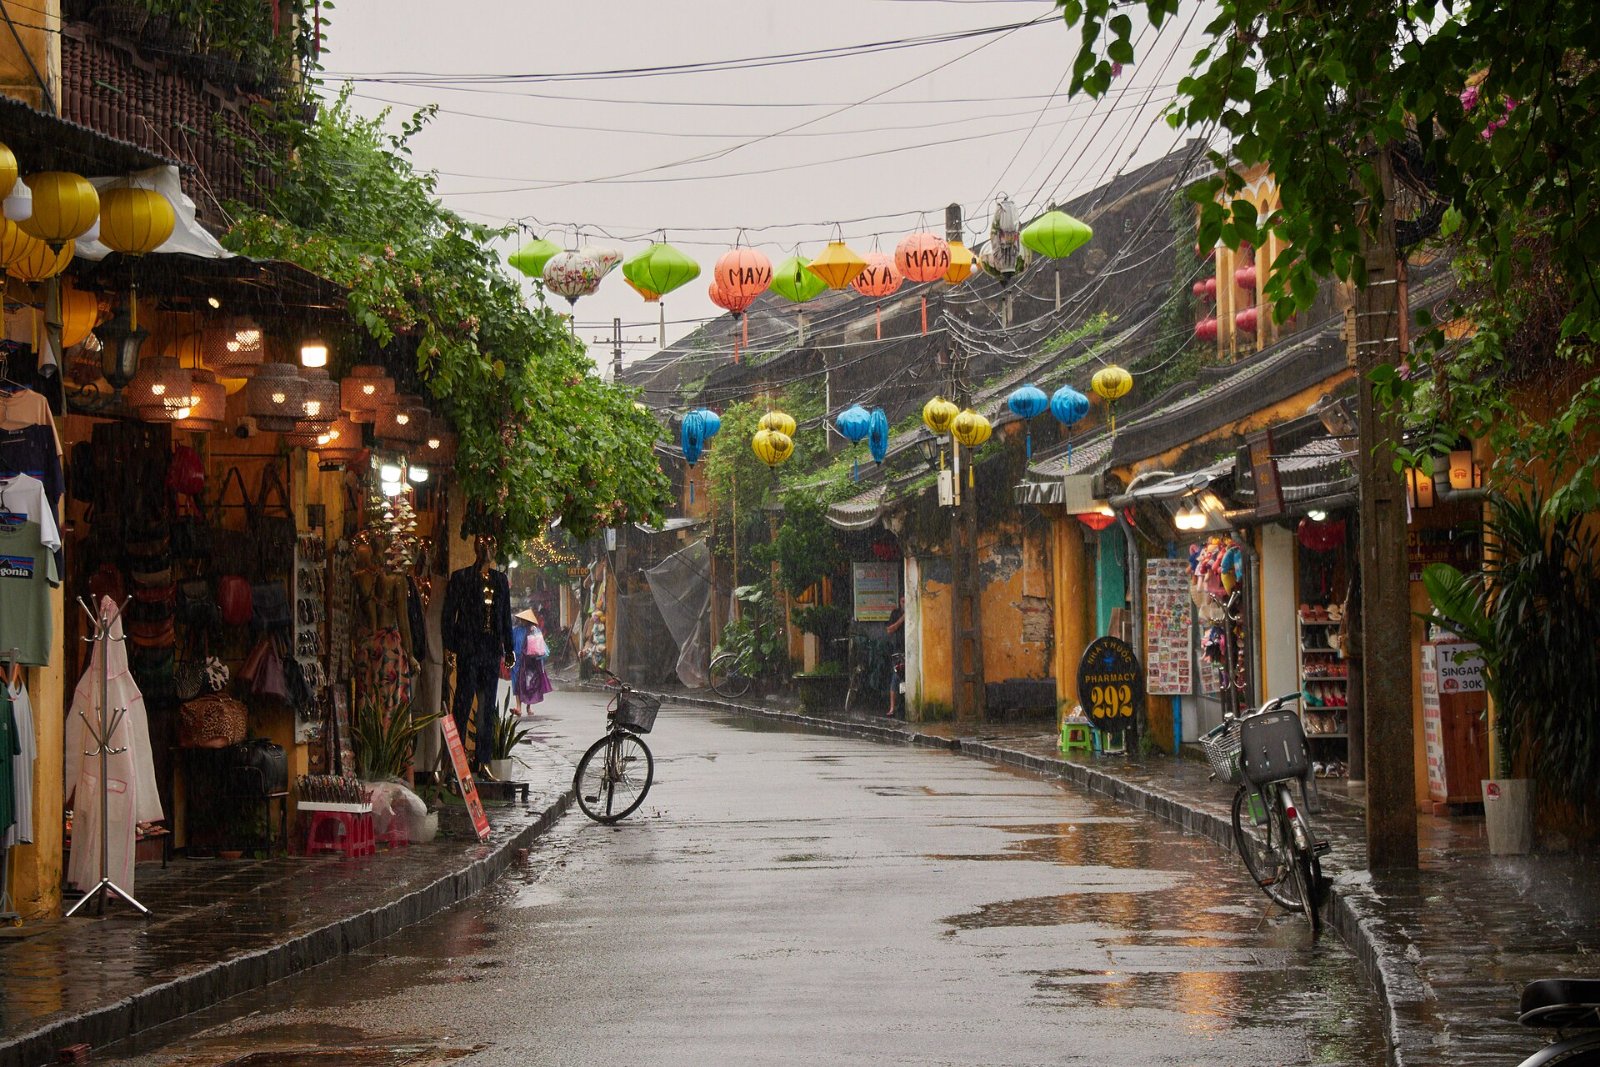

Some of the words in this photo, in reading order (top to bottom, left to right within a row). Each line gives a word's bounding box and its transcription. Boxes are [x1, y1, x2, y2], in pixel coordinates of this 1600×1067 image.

[905, 249, 949, 268] MAYA
[0, 568, 29, 577] gonia
[567, 567, 589, 575] TATTOO
[1085, 673, 1136, 683] PHARMACY
[1462, 679, 1482, 689] 30K
[1091, 685, 1133, 719] 292
